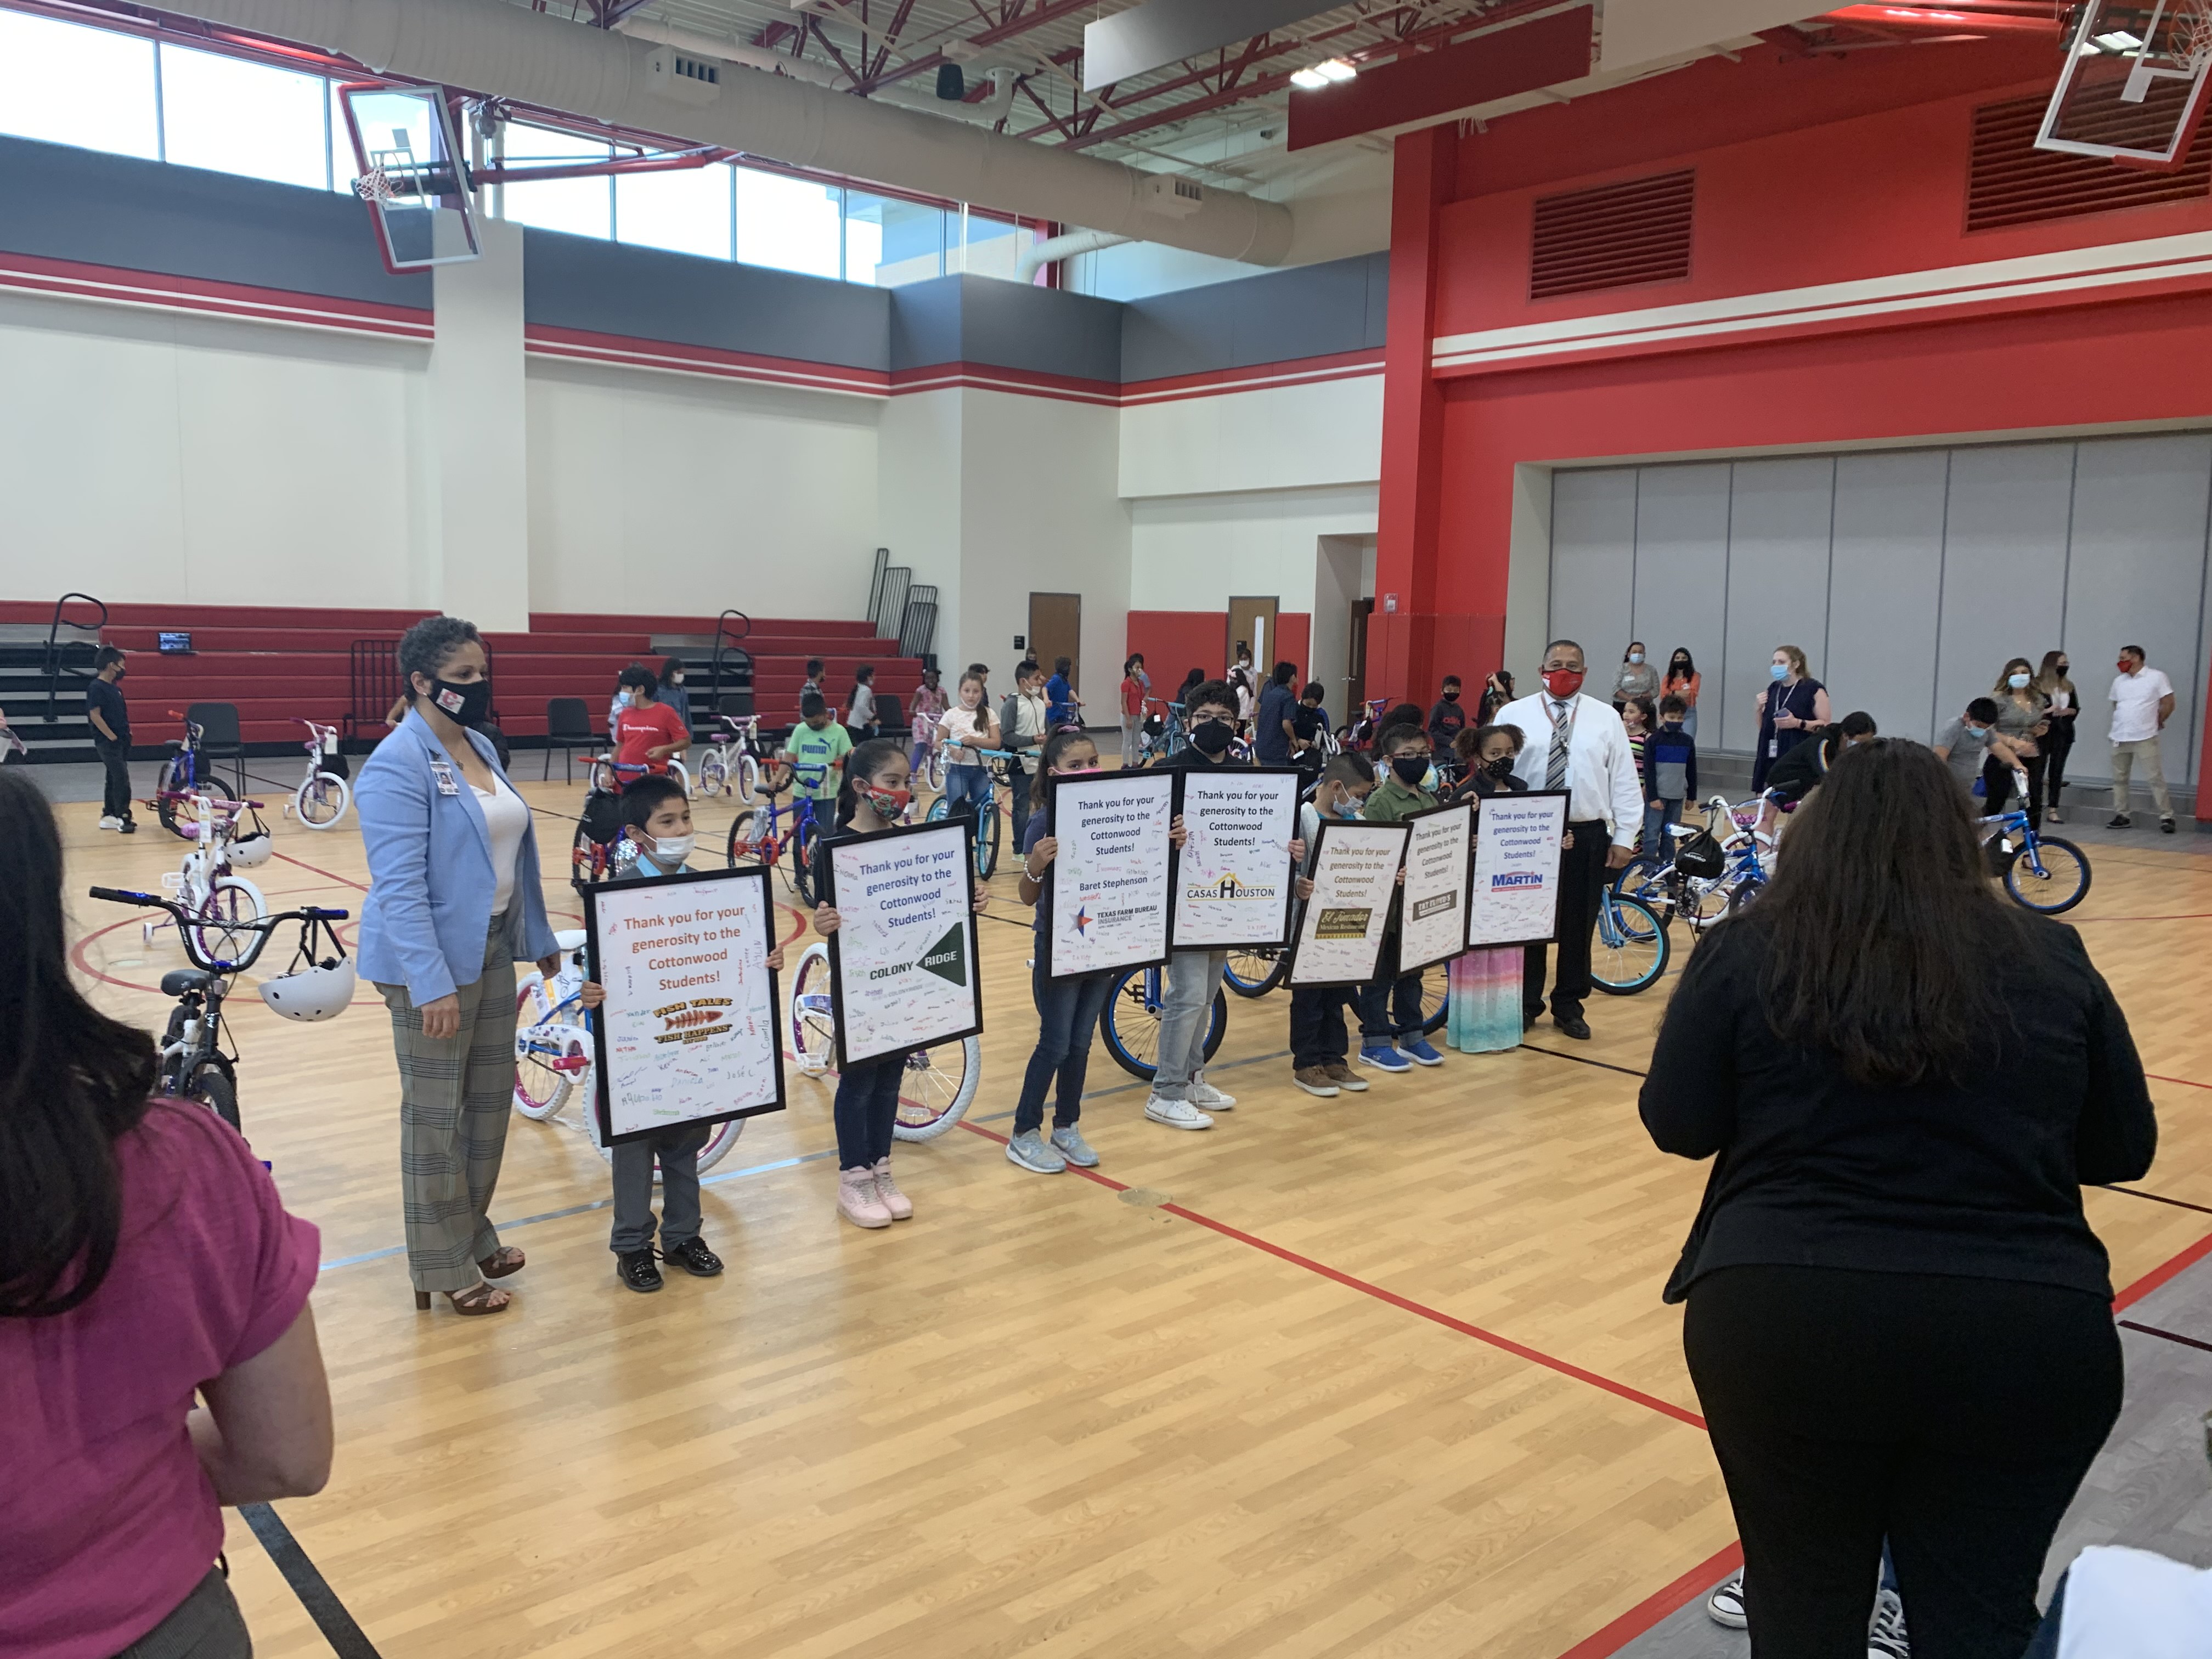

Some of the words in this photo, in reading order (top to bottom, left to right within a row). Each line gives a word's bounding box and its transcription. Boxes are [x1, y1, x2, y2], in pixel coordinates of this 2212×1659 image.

[802, 744, 827, 755] PUMA
[1198, 791, 1224, 799] Thank
[1226, 793, 1242, 801] you
[1245, 791, 1257, 799] for
[1260, 793, 1279, 802] your
[1078, 799, 1103, 810] Thank
[1105, 799, 1120, 809] you
[1123, 797, 1135, 806] for
[1136, 797, 1155, 806] your
[1200, 806, 1245, 817] generosity
[1259, 806, 1274, 815] the
[1492, 812, 1512, 821] Thank
[1081, 814, 1125, 828] generosity
[1126, 813, 1135, 821] to
[1137, 811, 1150, 820] the
[1209, 822, 1262, 831] Cottonwood
[1415, 831, 1431, 841] Thank
[1431, 829, 1442, 838] you
[1450, 823, 1462, 833] your
[1493, 825, 1528, 836] generosity
[1091, 827, 1141, 840] Cottonwood
[1214, 837, 1256, 846] Students!
[1500, 837, 1541, 847] Cottonwood
[1096, 842, 1135, 856] Students!
[1330, 847, 1350, 855] Thank
[1364, 847, 1375, 855] for
[1417, 842, 1443, 856] generosity
[1504, 850, 1536, 859] Students!
[860, 860, 891, 875] Thank
[894, 858, 912, 871] you
[915, 854, 929, 865] for
[932, 850, 955, 863] your
[1422, 850, 1453, 866] Cottonwood
[1329, 861, 1364, 871] generosity
[1373, 861, 1385, 870] the
[1424, 865, 1448, 879] Students!
[866, 875, 919, 896] generosity
[922, 872, 932, 883] to
[935, 868, 952, 880] the
[1079, 882, 1101, 891] Baret
[1103, 876, 1148, 889] Stephenson
[1334, 875, 1375, 883] Cottonwood
[1187, 889, 1217, 899] CASAS
[1220, 879, 1275, 899] HOUSTON
[1335, 889, 1367, 898] Students!
[880, 888, 941, 911] Cottonwood
[888, 907, 936, 928] Students!
[1097, 910, 1116, 918] TEXAS
[1135, 905, 1158, 914] BUREAU
[1321, 911, 1335, 923] El
[1333, 911, 1368, 923] Jimador
[624, 915, 664, 930] Thank
[668, 913, 691, 927] you
[695, 909, 713, 921] for
[717, 907, 745, 921] your
[1098, 915, 1133, 925] INSURANCE
[632, 933, 699, 953] generosity
[703, 931, 716, 941] to
[720, 927, 741, 939] the
[648, 948, 727, 970] Cottonwood
[870, 961, 914, 980] COLONY
[924, 950, 957, 967] RIDGE
[659, 970, 720, 990] Students!
[653, 1002, 687, 1018] FISH
[689, 998, 733, 1008] TALES
